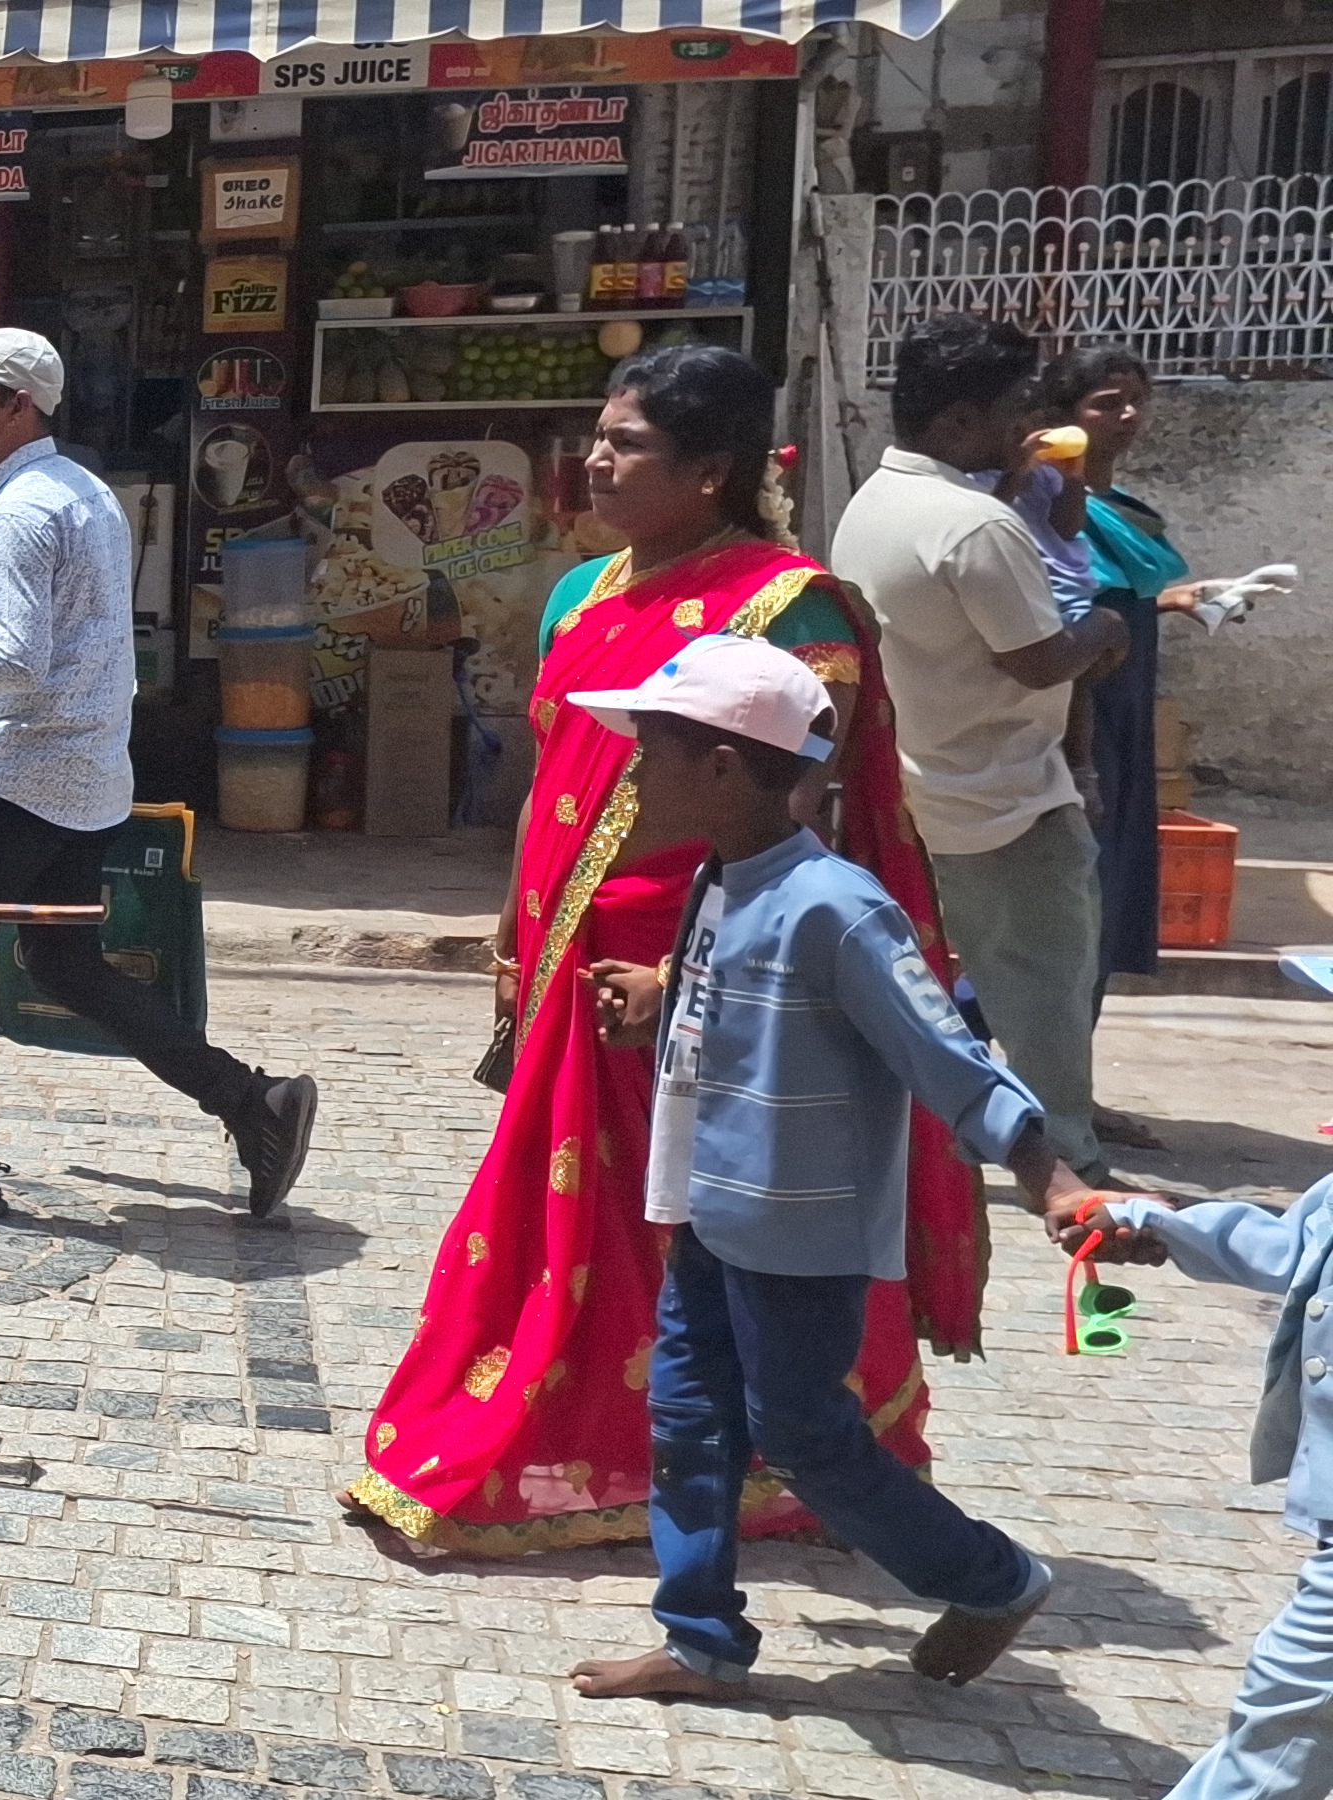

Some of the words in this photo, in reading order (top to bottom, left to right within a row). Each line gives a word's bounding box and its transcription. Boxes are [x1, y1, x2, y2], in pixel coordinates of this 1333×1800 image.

[274, 62, 326, 88] SPS
[334, 58, 411, 85] JUICE
[478, 86, 628, 133] ஜிகர்தண்டா
[463, 136, 623, 167] JIGARTHANDA
